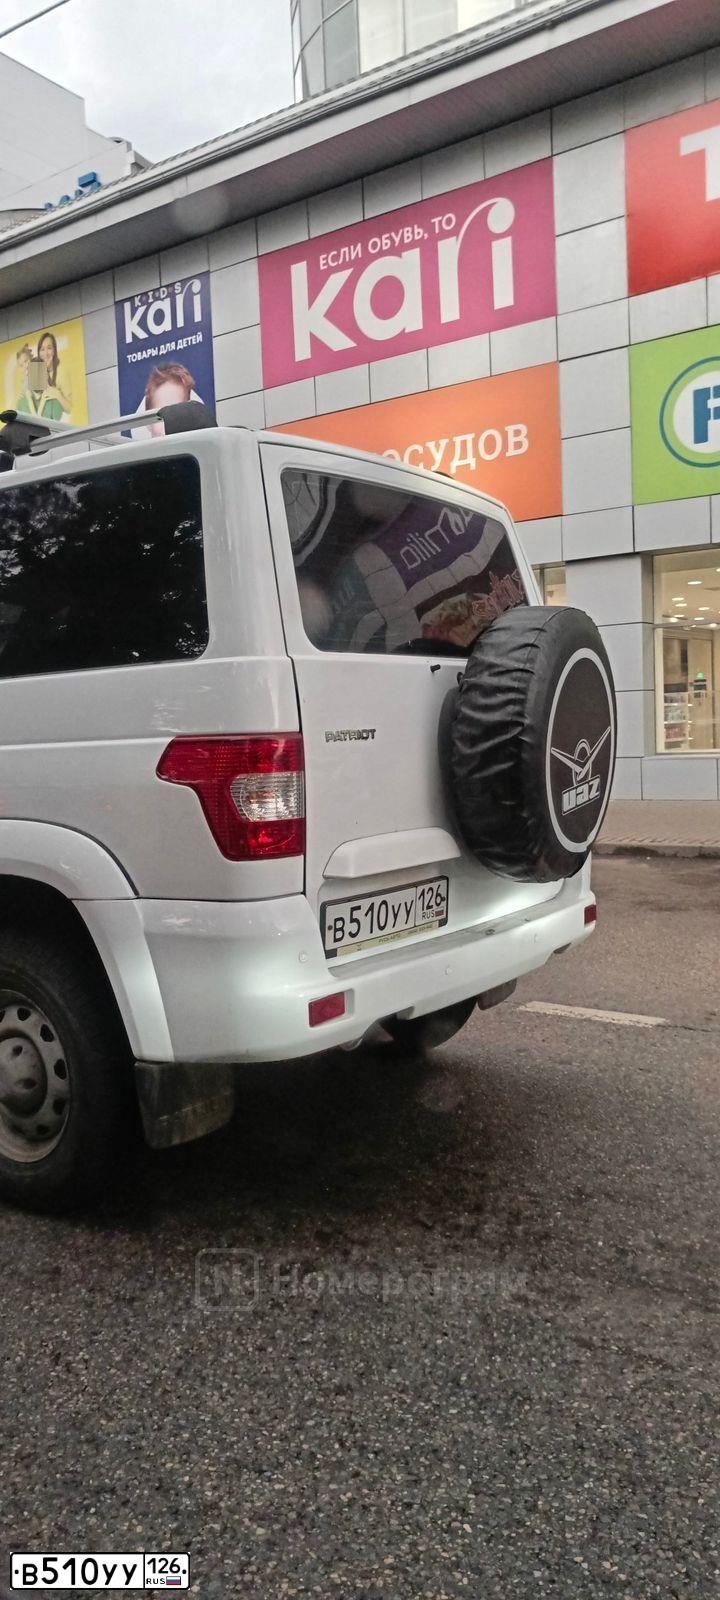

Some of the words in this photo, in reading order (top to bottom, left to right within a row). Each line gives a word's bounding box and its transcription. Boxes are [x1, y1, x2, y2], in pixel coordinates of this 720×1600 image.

[319, 243, 362, 270] ЕСЛИ
[367, 226, 428, 254] ОБУВЬ,
[431, 213, 456, 234] ТО
[290, 197, 515, 362] kari
[123, 279, 202, 344] kari
[126, 346, 158, 364] ТОВАРЫ
[159, 341, 176, 355] ДЛЯ
[177, 332, 203, 350] ДЕТЕЙ
[325, 729, 376, 743] PATRIOT
[418, 884, 442, 911] 126
[422, 909, 435, 919] RUS
